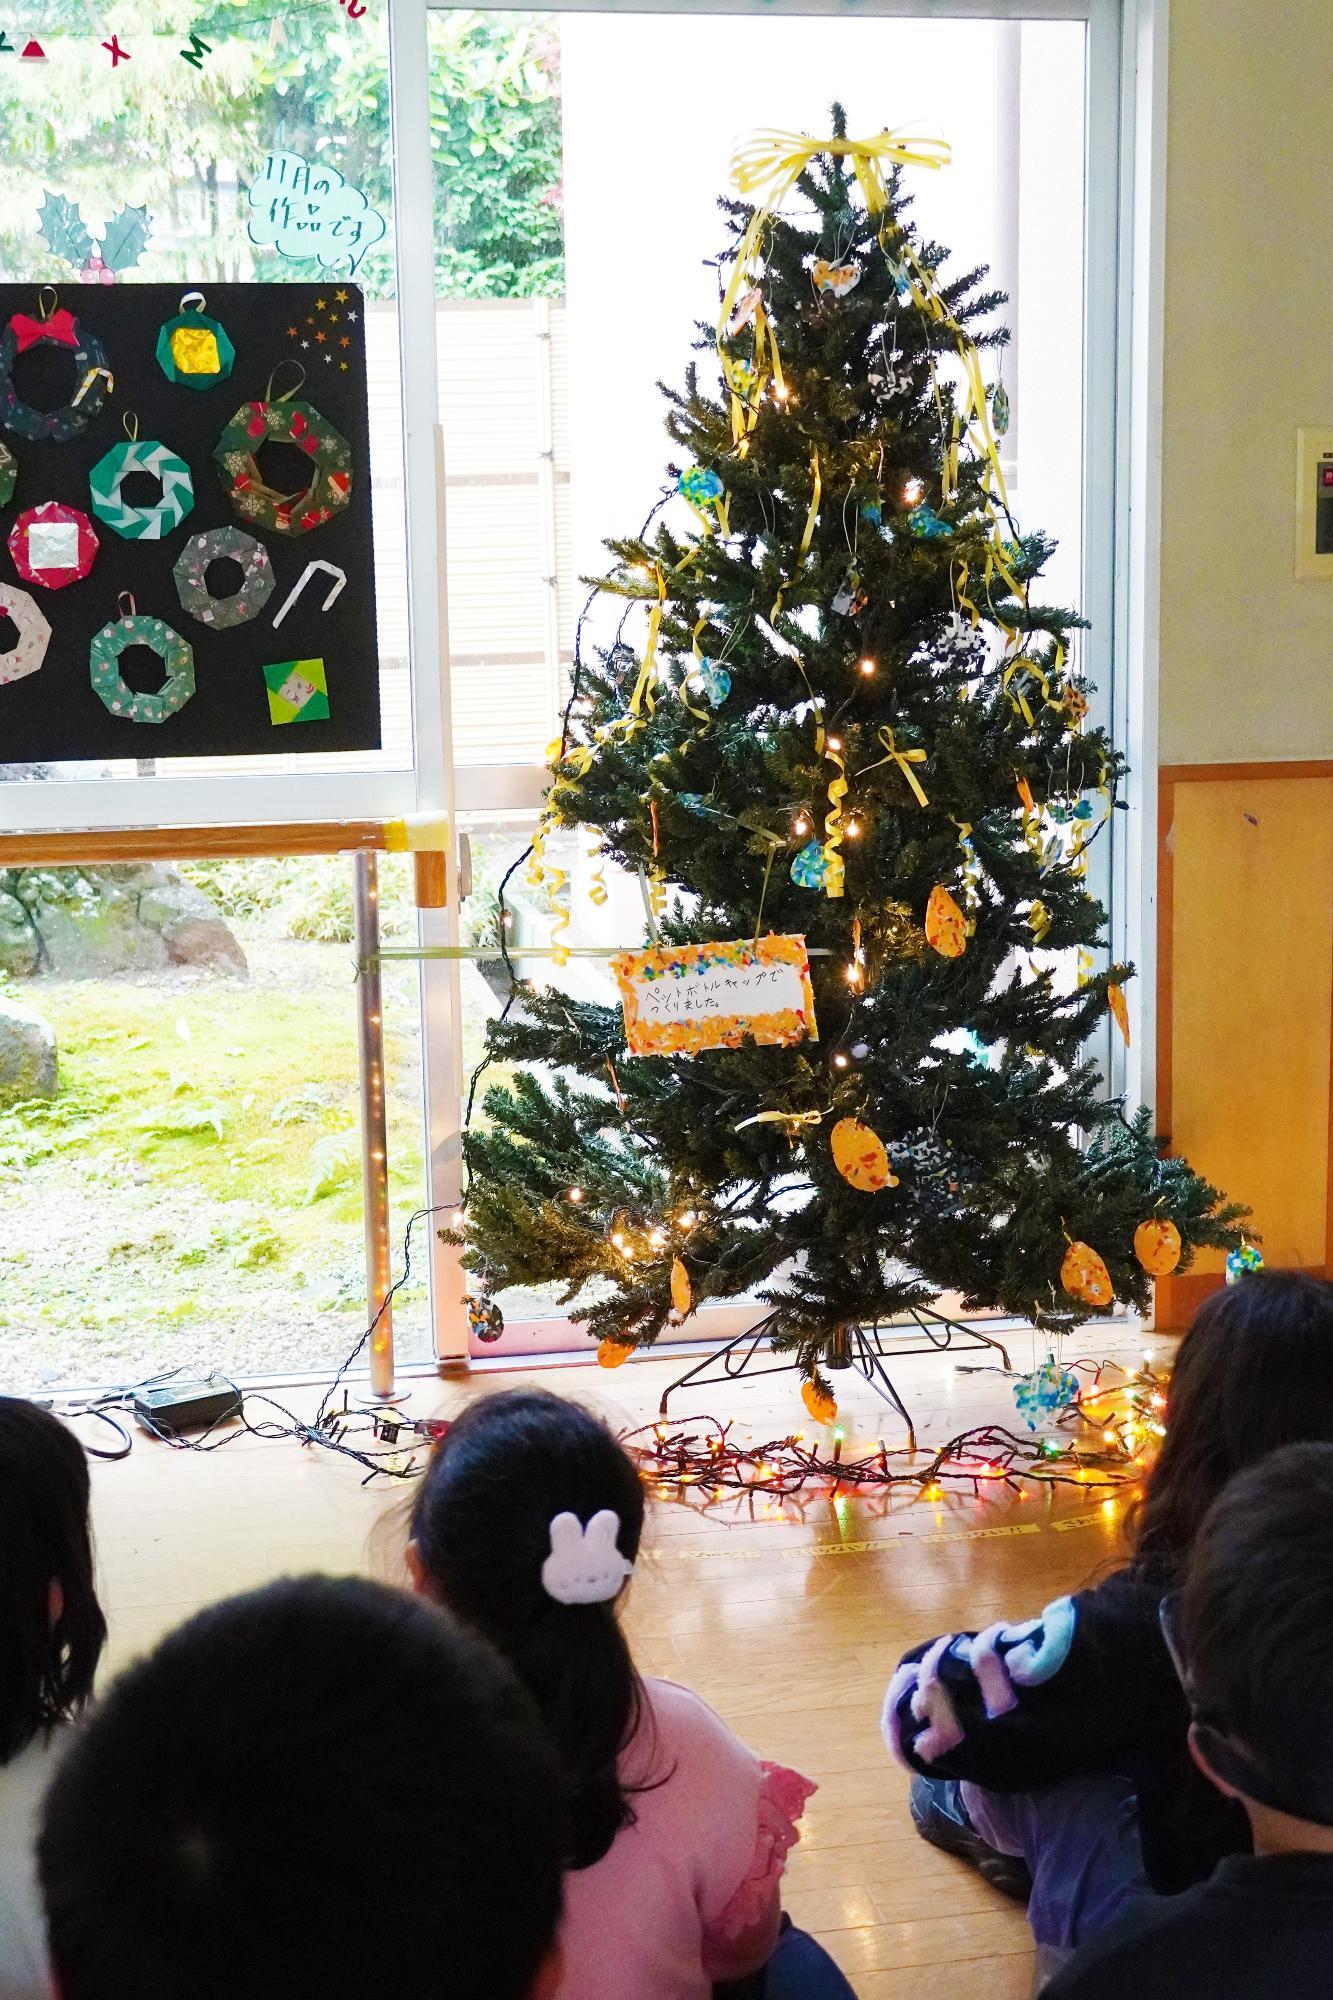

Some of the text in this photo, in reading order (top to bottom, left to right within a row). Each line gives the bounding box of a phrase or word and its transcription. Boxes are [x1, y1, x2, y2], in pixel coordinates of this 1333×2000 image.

[266, 156, 330, 196] 11月の
[269, 196, 366, 247] 作品です
[645, 968, 784, 1004] ペットボトルキャップで
[650, 996, 720, 1014] つくりました。
